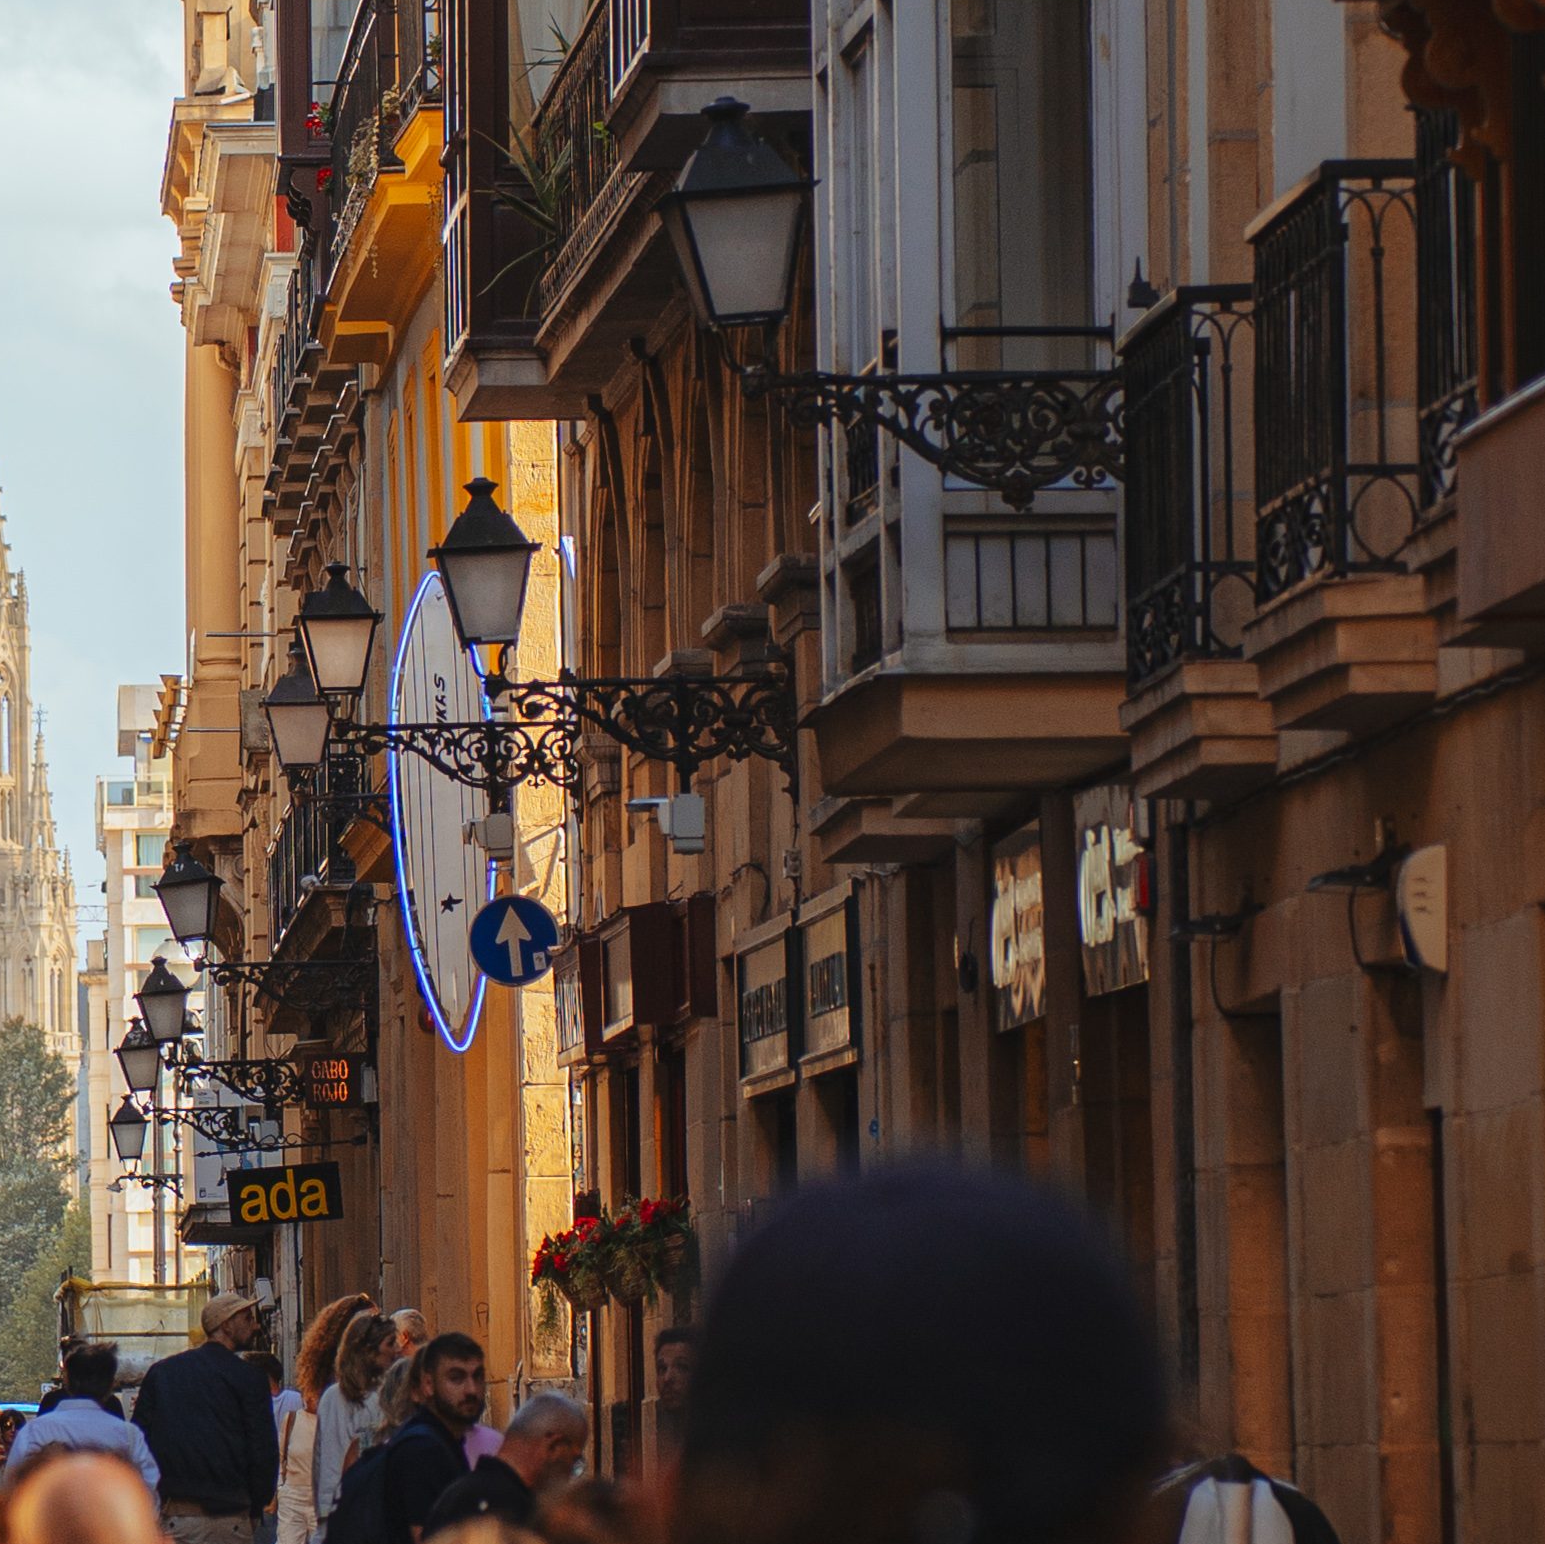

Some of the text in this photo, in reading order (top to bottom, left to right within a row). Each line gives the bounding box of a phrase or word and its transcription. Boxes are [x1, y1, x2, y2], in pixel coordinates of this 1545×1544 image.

[311, 1059, 349, 1079] CABO
[313, 1081, 348, 1102] ROJO
[240, 1169, 329, 1223] ada
